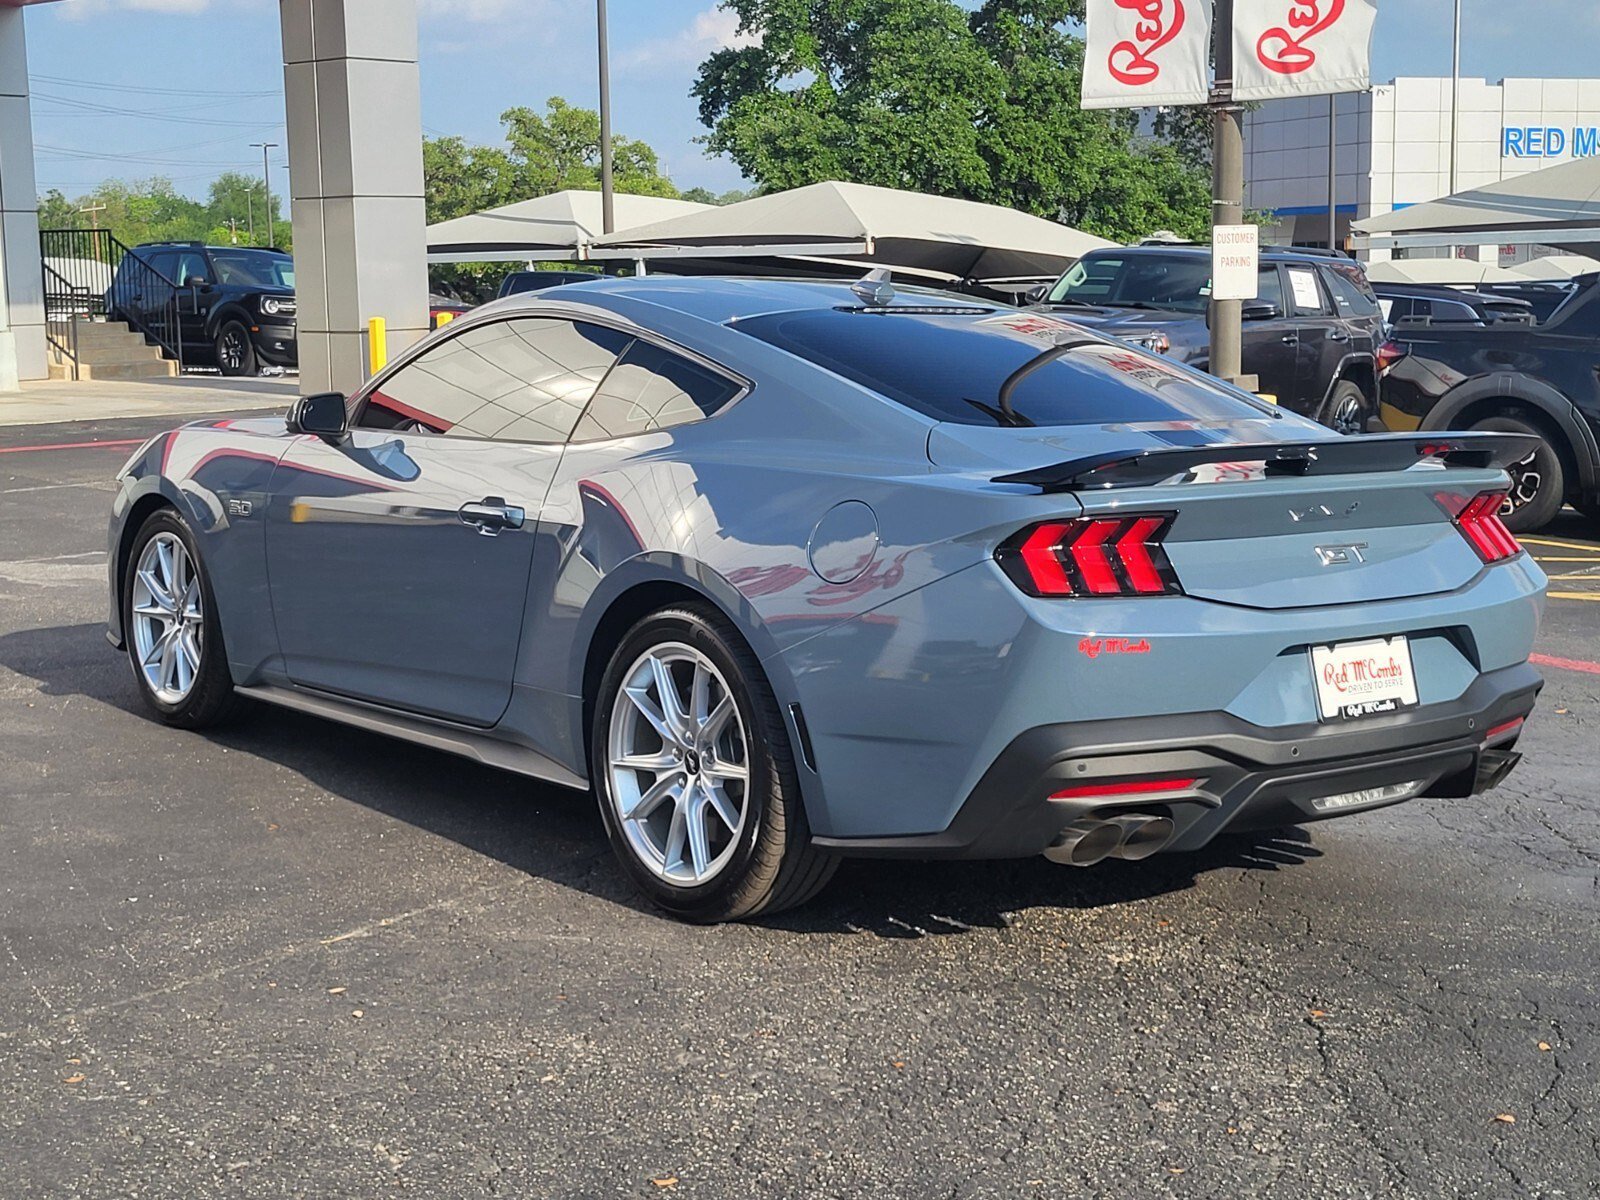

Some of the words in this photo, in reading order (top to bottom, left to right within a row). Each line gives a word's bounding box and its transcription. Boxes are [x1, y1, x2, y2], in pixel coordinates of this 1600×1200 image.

[1501, 126, 1566, 157] RED
[1216, 232, 1255, 245] CUSTOMER
[1220, 255, 1251, 268] PARKING
[1314, 542, 1369, 566] GT
[1078, 637, 1102, 659] Red
[1323, 662, 1349, 693] Red
[1349, 657, 1402, 681] McCombs
[1348, 682, 1373, 694] DRIVEN
[1374, 680, 1383, 690] TO
[1384, 677, 1404, 688] SERVE
[1347, 703, 1363, 717] Red
